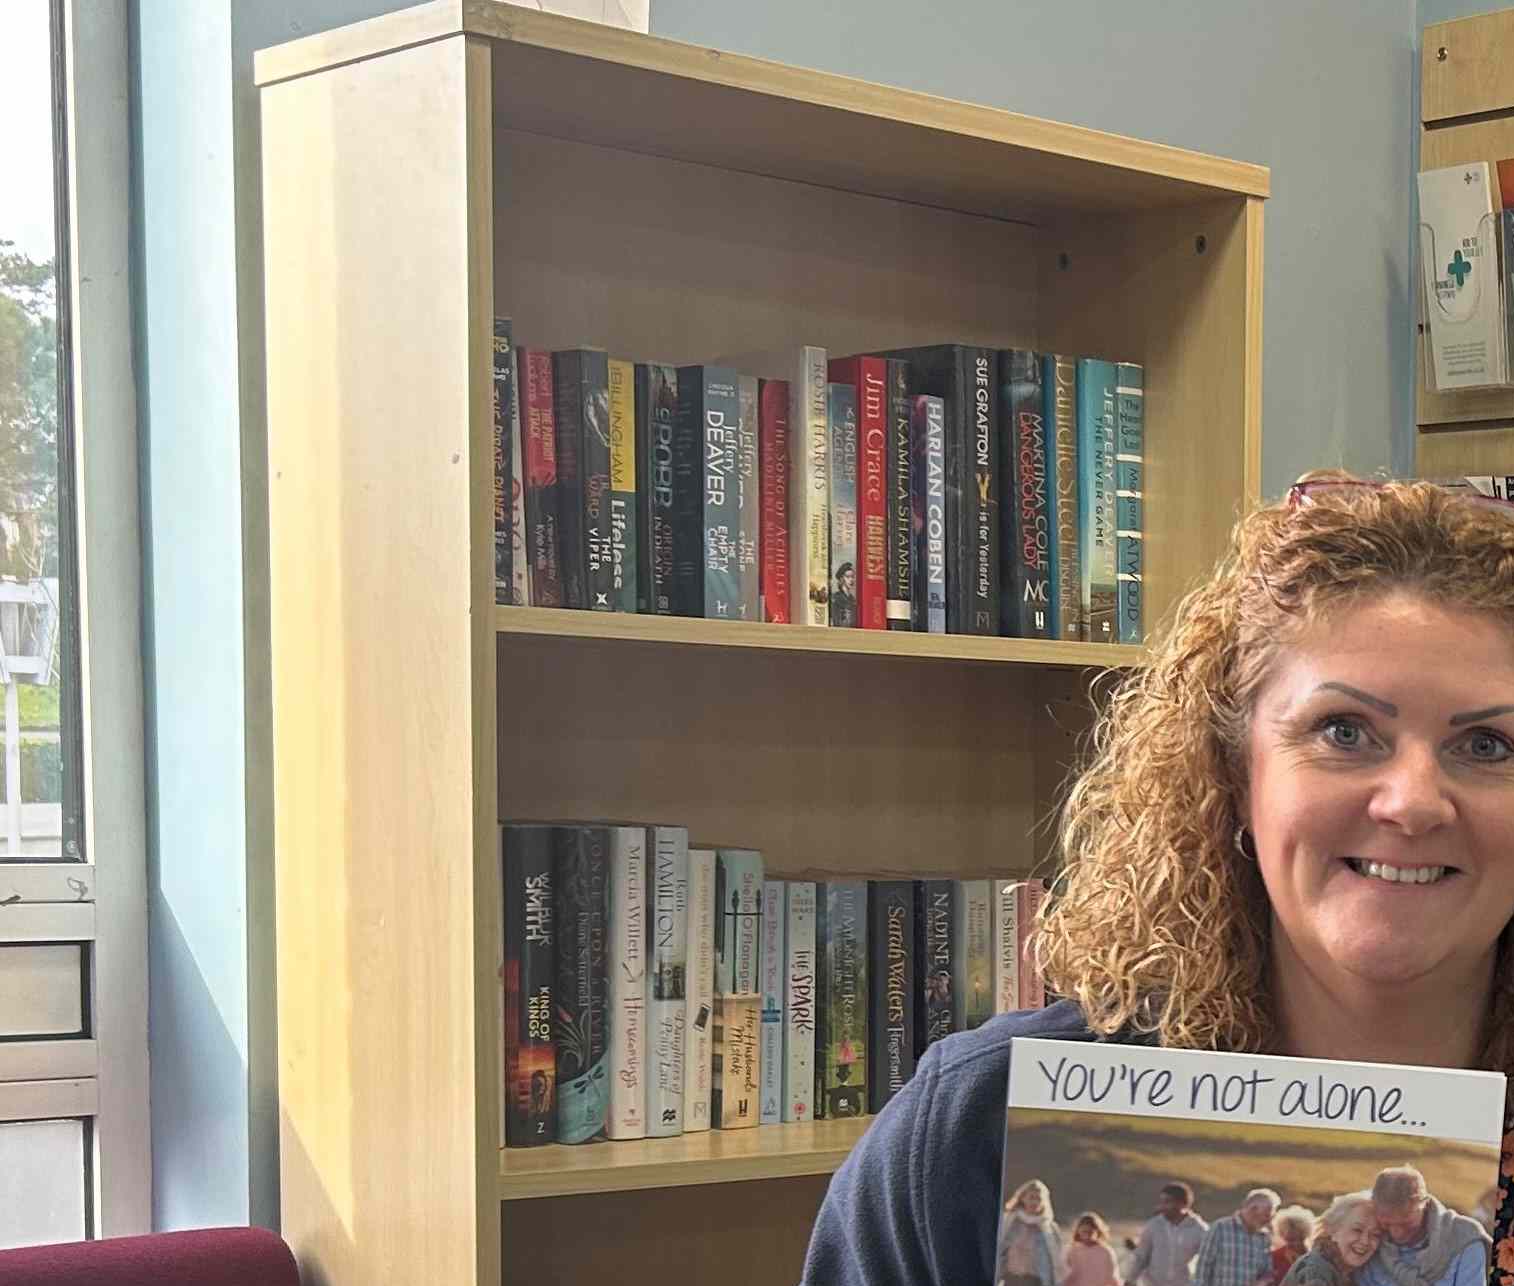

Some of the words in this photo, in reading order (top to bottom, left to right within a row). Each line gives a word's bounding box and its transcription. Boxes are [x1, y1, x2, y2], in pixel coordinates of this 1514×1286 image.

[866, 374, 884, 419] Jim
[976, 357, 988, 387] SUE
[976, 389, 989, 466] GRAFTON
[1055, 361, 1077, 469] Danielle
[1103, 387, 1114, 481] JEFFERY
[706, 411, 724, 505] DEAVER
[723, 424, 737, 473] Jeffery
[866, 428, 884, 502] Crace
[896, 418, 910, 501] KAMILA
[927, 403, 944, 495] HARLAN
[1019, 411, 1035, 519] DANGEROUS
[1032, 414, 1046, 508] MARTINA
[706, 528, 718, 570] CHAIR
[717, 525, 728, 573] EMPTY
[928, 504, 944, 584] COBEN
[978, 525, 990, 542] for
[1022, 526, 1037, 570] LADY
[1035, 514, 1048, 571] COLE
[1095, 507, 1104, 548] GAME
[976, 543, 990, 599] Yesterday
[1126, 536, 1139, 622] ATWOOD
[627, 845, 642, 900] Marcia
[657, 839, 674, 949] HAMILTON
[524, 876, 543, 941] SMITH
[888, 905, 907, 959] Sarah
[934, 893, 948, 966] NADINE
[528, 996, 539, 1038] KINGS
[539, 986, 551, 1020] KING
[790, 974, 814, 1031] SPARK
[888, 960, 906, 1022] Waters
[539, 1023, 551, 1041] OF
[1038, 1057, 1173, 1109] You're
[1190, 1070, 1275, 1114] not
[1279, 1074, 1428, 1128] alone...
